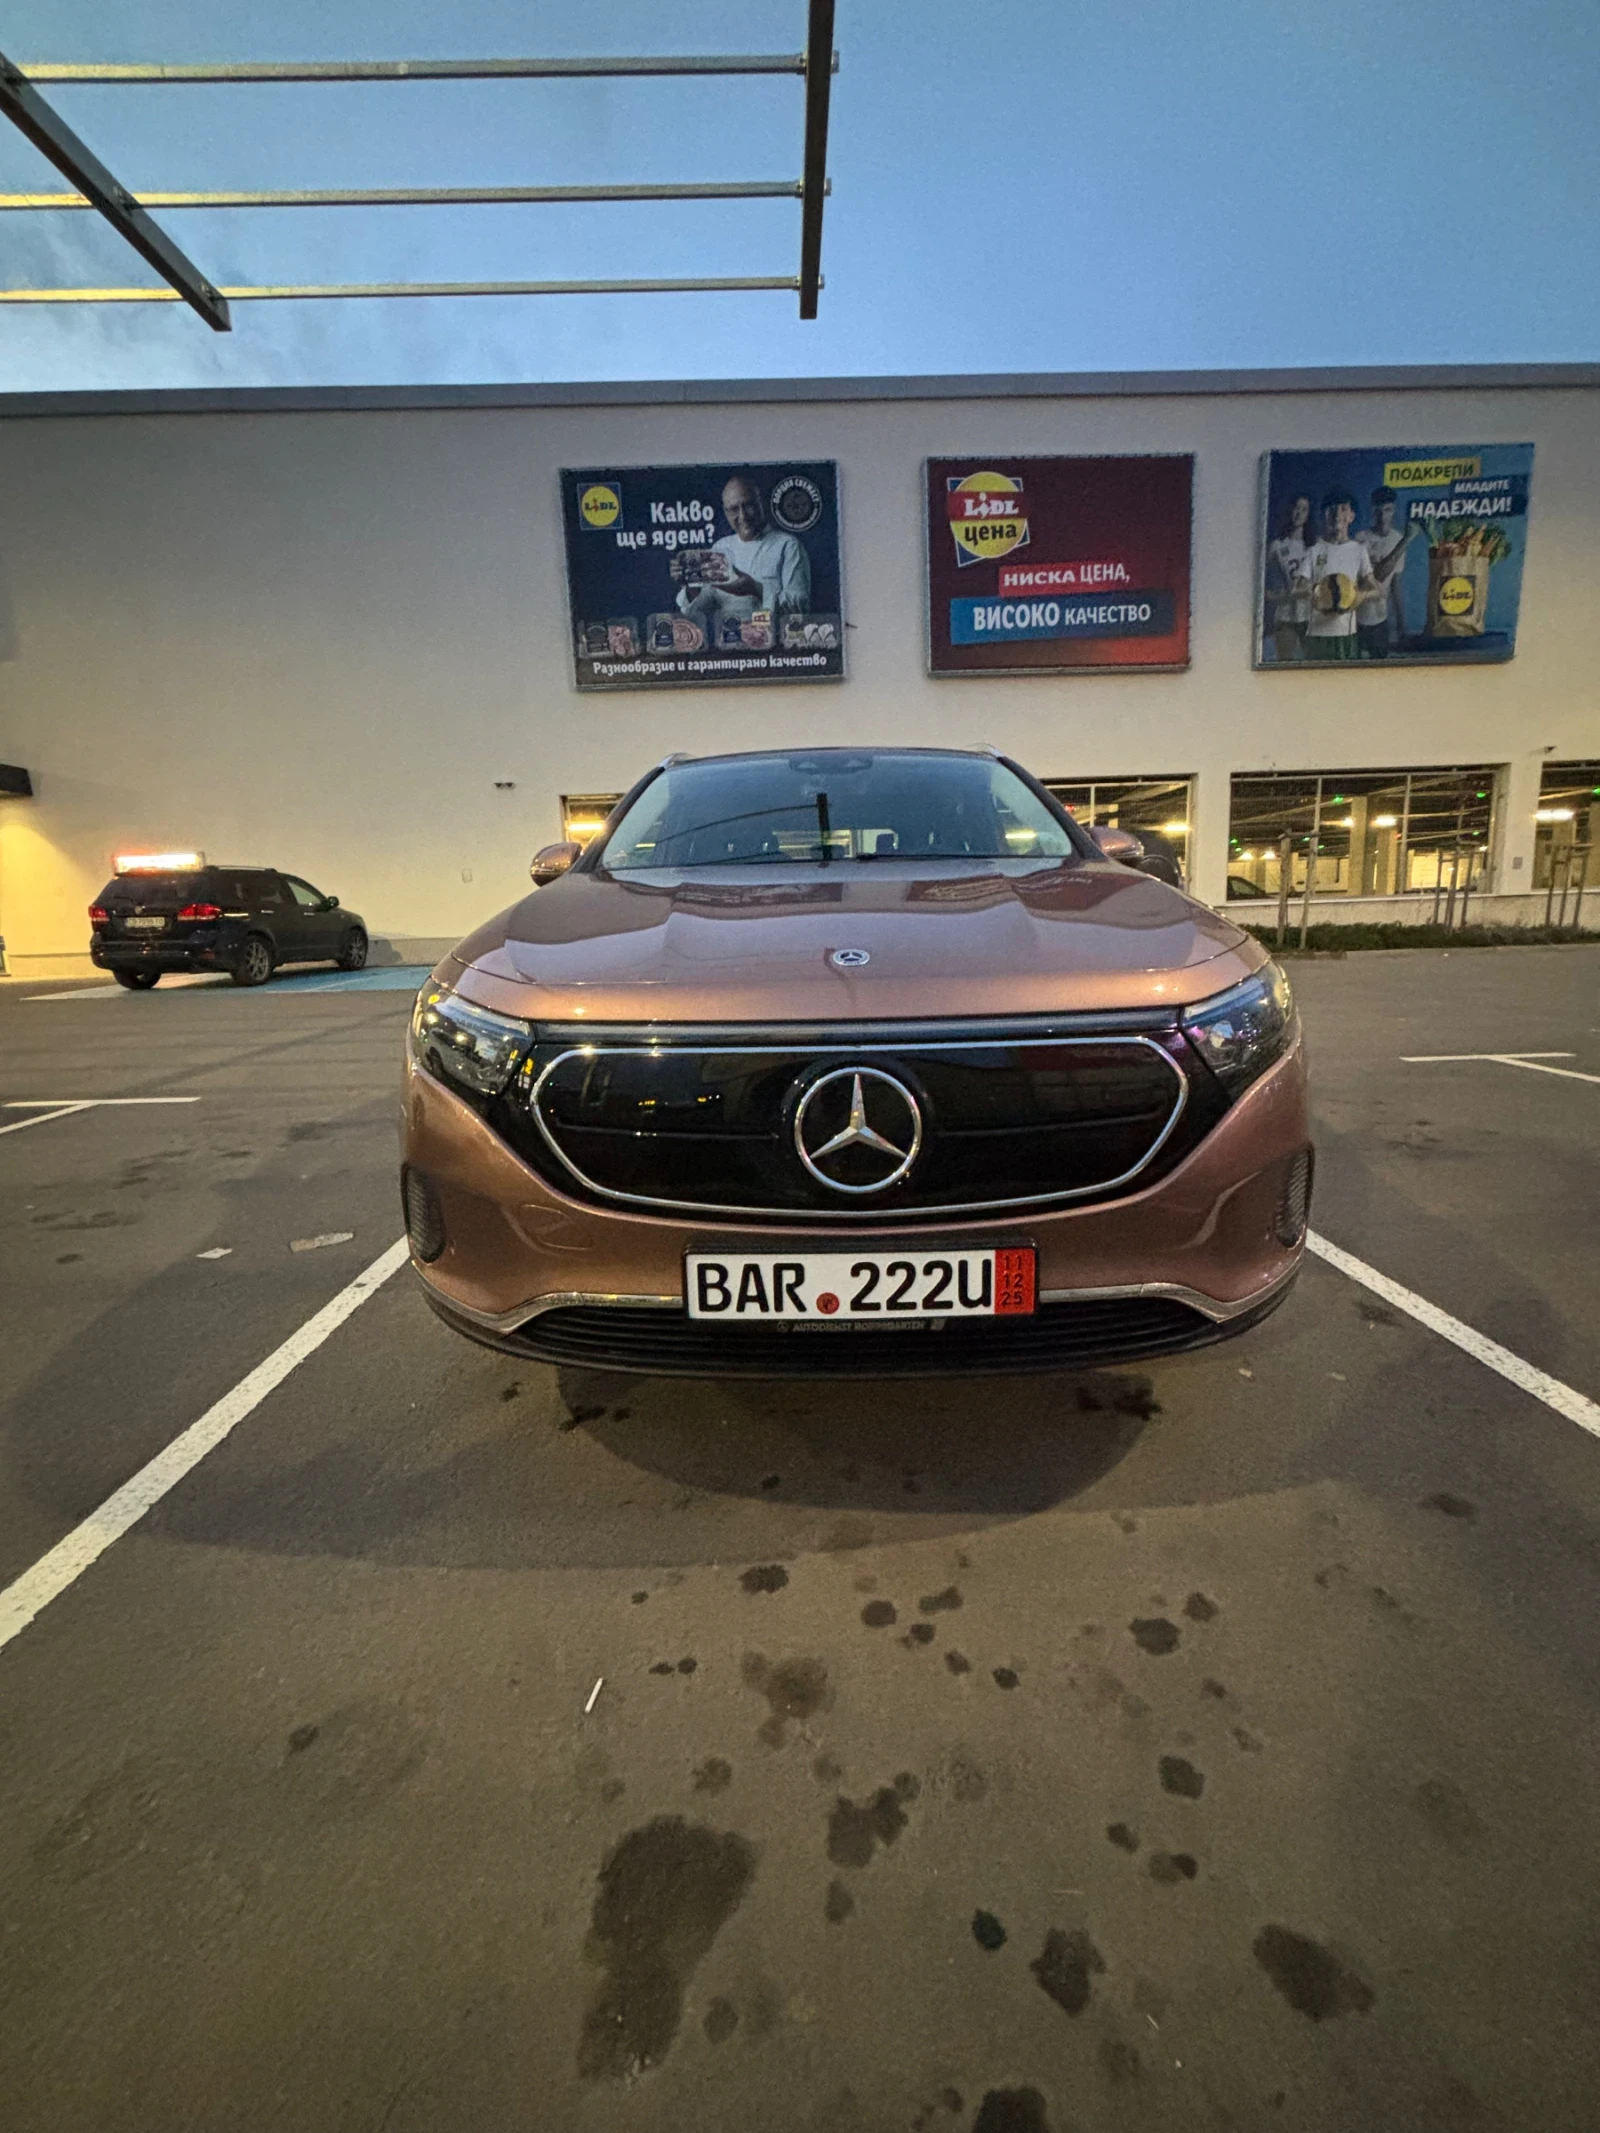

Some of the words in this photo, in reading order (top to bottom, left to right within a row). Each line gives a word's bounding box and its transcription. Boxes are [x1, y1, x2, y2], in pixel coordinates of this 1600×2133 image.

[1389, 463, 1474, 481] ПОДКРЕПИ
[1454, 479, 1510, 493] МЛАДИТЕ
[650, 500, 715, 524] Какво
[1410, 496, 1512, 519] НАДЕЖДИ!
[616, 531, 647, 550] ще
[651, 524, 716, 550] ядем?
[964, 522, 1018, 546] цена
[1003, 569, 1075, 587] НИСКА
[1079, 563, 1131, 584] ЦЕНА,
[973, 602, 1060, 631] ВИСОКО
[1064, 603, 1151, 626] КАЧЕСТВО
[592, 659, 676, 676] Разнообразие
[677, 662, 686, 672] и
[687, 657, 768, 673] гарантирано
[769, 653, 828, 668] качество
[1004, 1254, 1022, 1270] 11
[697, 1262, 808, 1313] BAR
[850, 1258, 993, 1311] 222U
[1002, 1272, 1024, 1288] 12
[1001, 1290, 1024, 1306] 25
